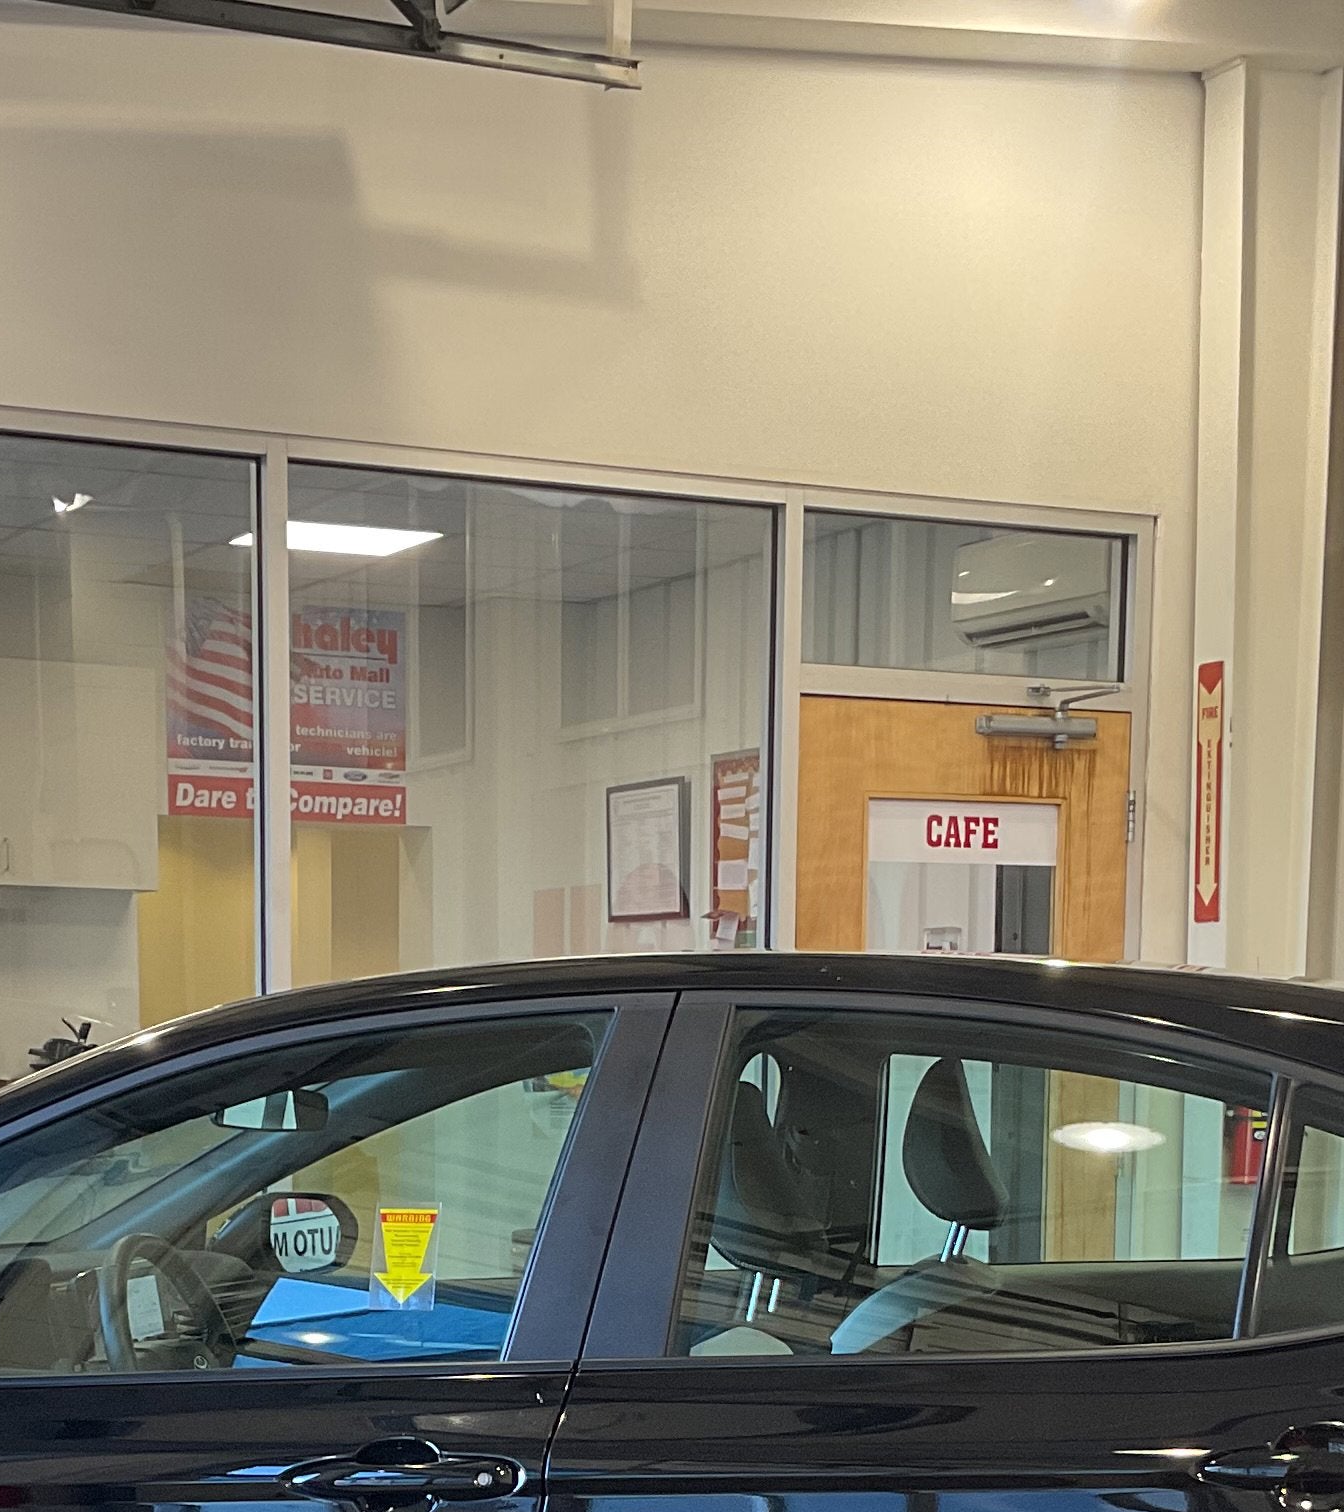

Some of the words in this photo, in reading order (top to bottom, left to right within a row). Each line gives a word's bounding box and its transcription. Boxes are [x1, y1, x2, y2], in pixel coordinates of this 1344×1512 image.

[292, 613, 398, 664] haley
[350, 665, 390, 684] Mall
[293, 684, 396, 709] SERVICE
[1201, 705, 1219, 720] FIRE
[177, 733, 224, 751] factory
[229, 737, 253, 750] trai
[296, 723, 371, 740] technicians
[376, 731, 398, 742] are
[289, 742, 301, 753] or
[346, 745, 398, 758] vehicle!
[175, 782, 237, 810] Dare
[1203, 738, 1214, 867] EXTINGUISHER
[926, 814, 1000, 850] CAFE
[385, 1213, 432, 1223] WARNING
